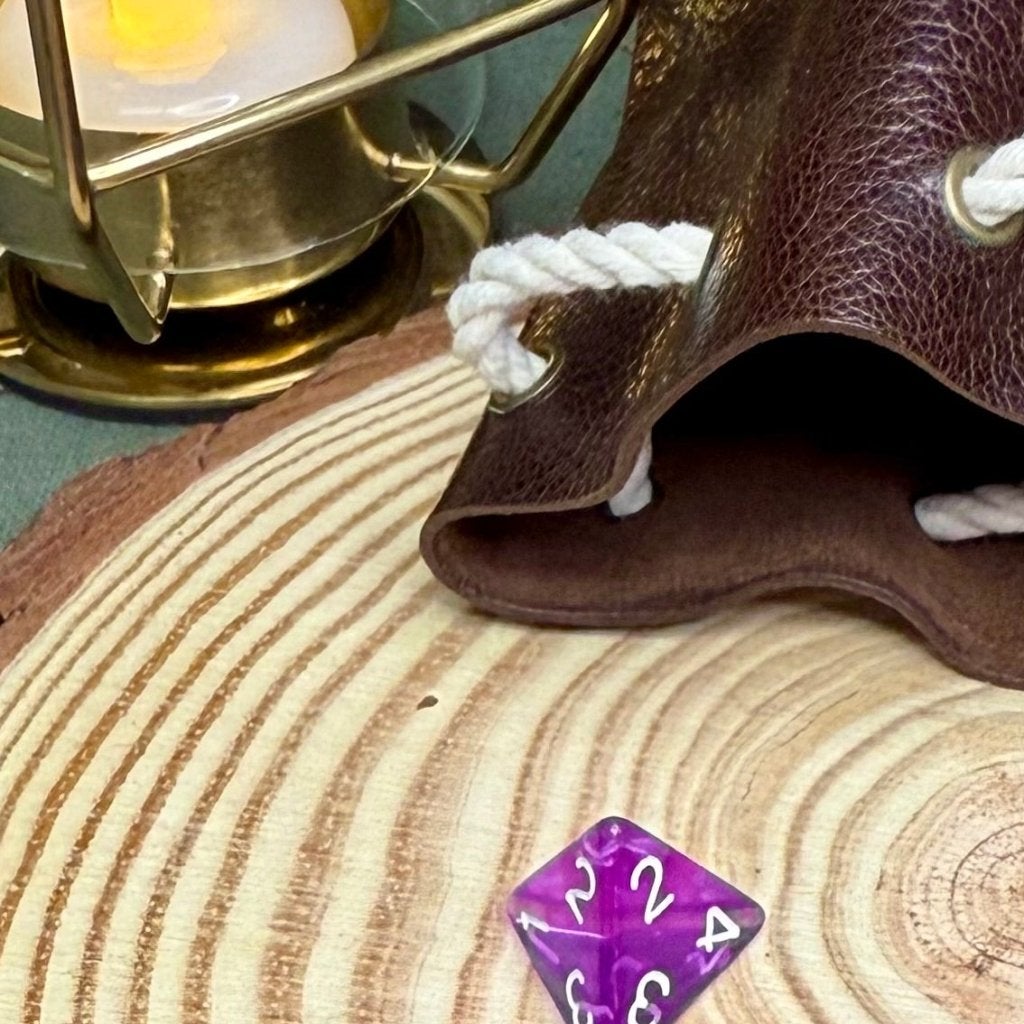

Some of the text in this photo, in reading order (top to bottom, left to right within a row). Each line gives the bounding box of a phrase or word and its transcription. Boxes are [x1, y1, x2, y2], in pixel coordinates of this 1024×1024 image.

[564, 856, 597, 925] 2
[630, 854, 675, 925] 2
[695, 905, 741, 953] 4
